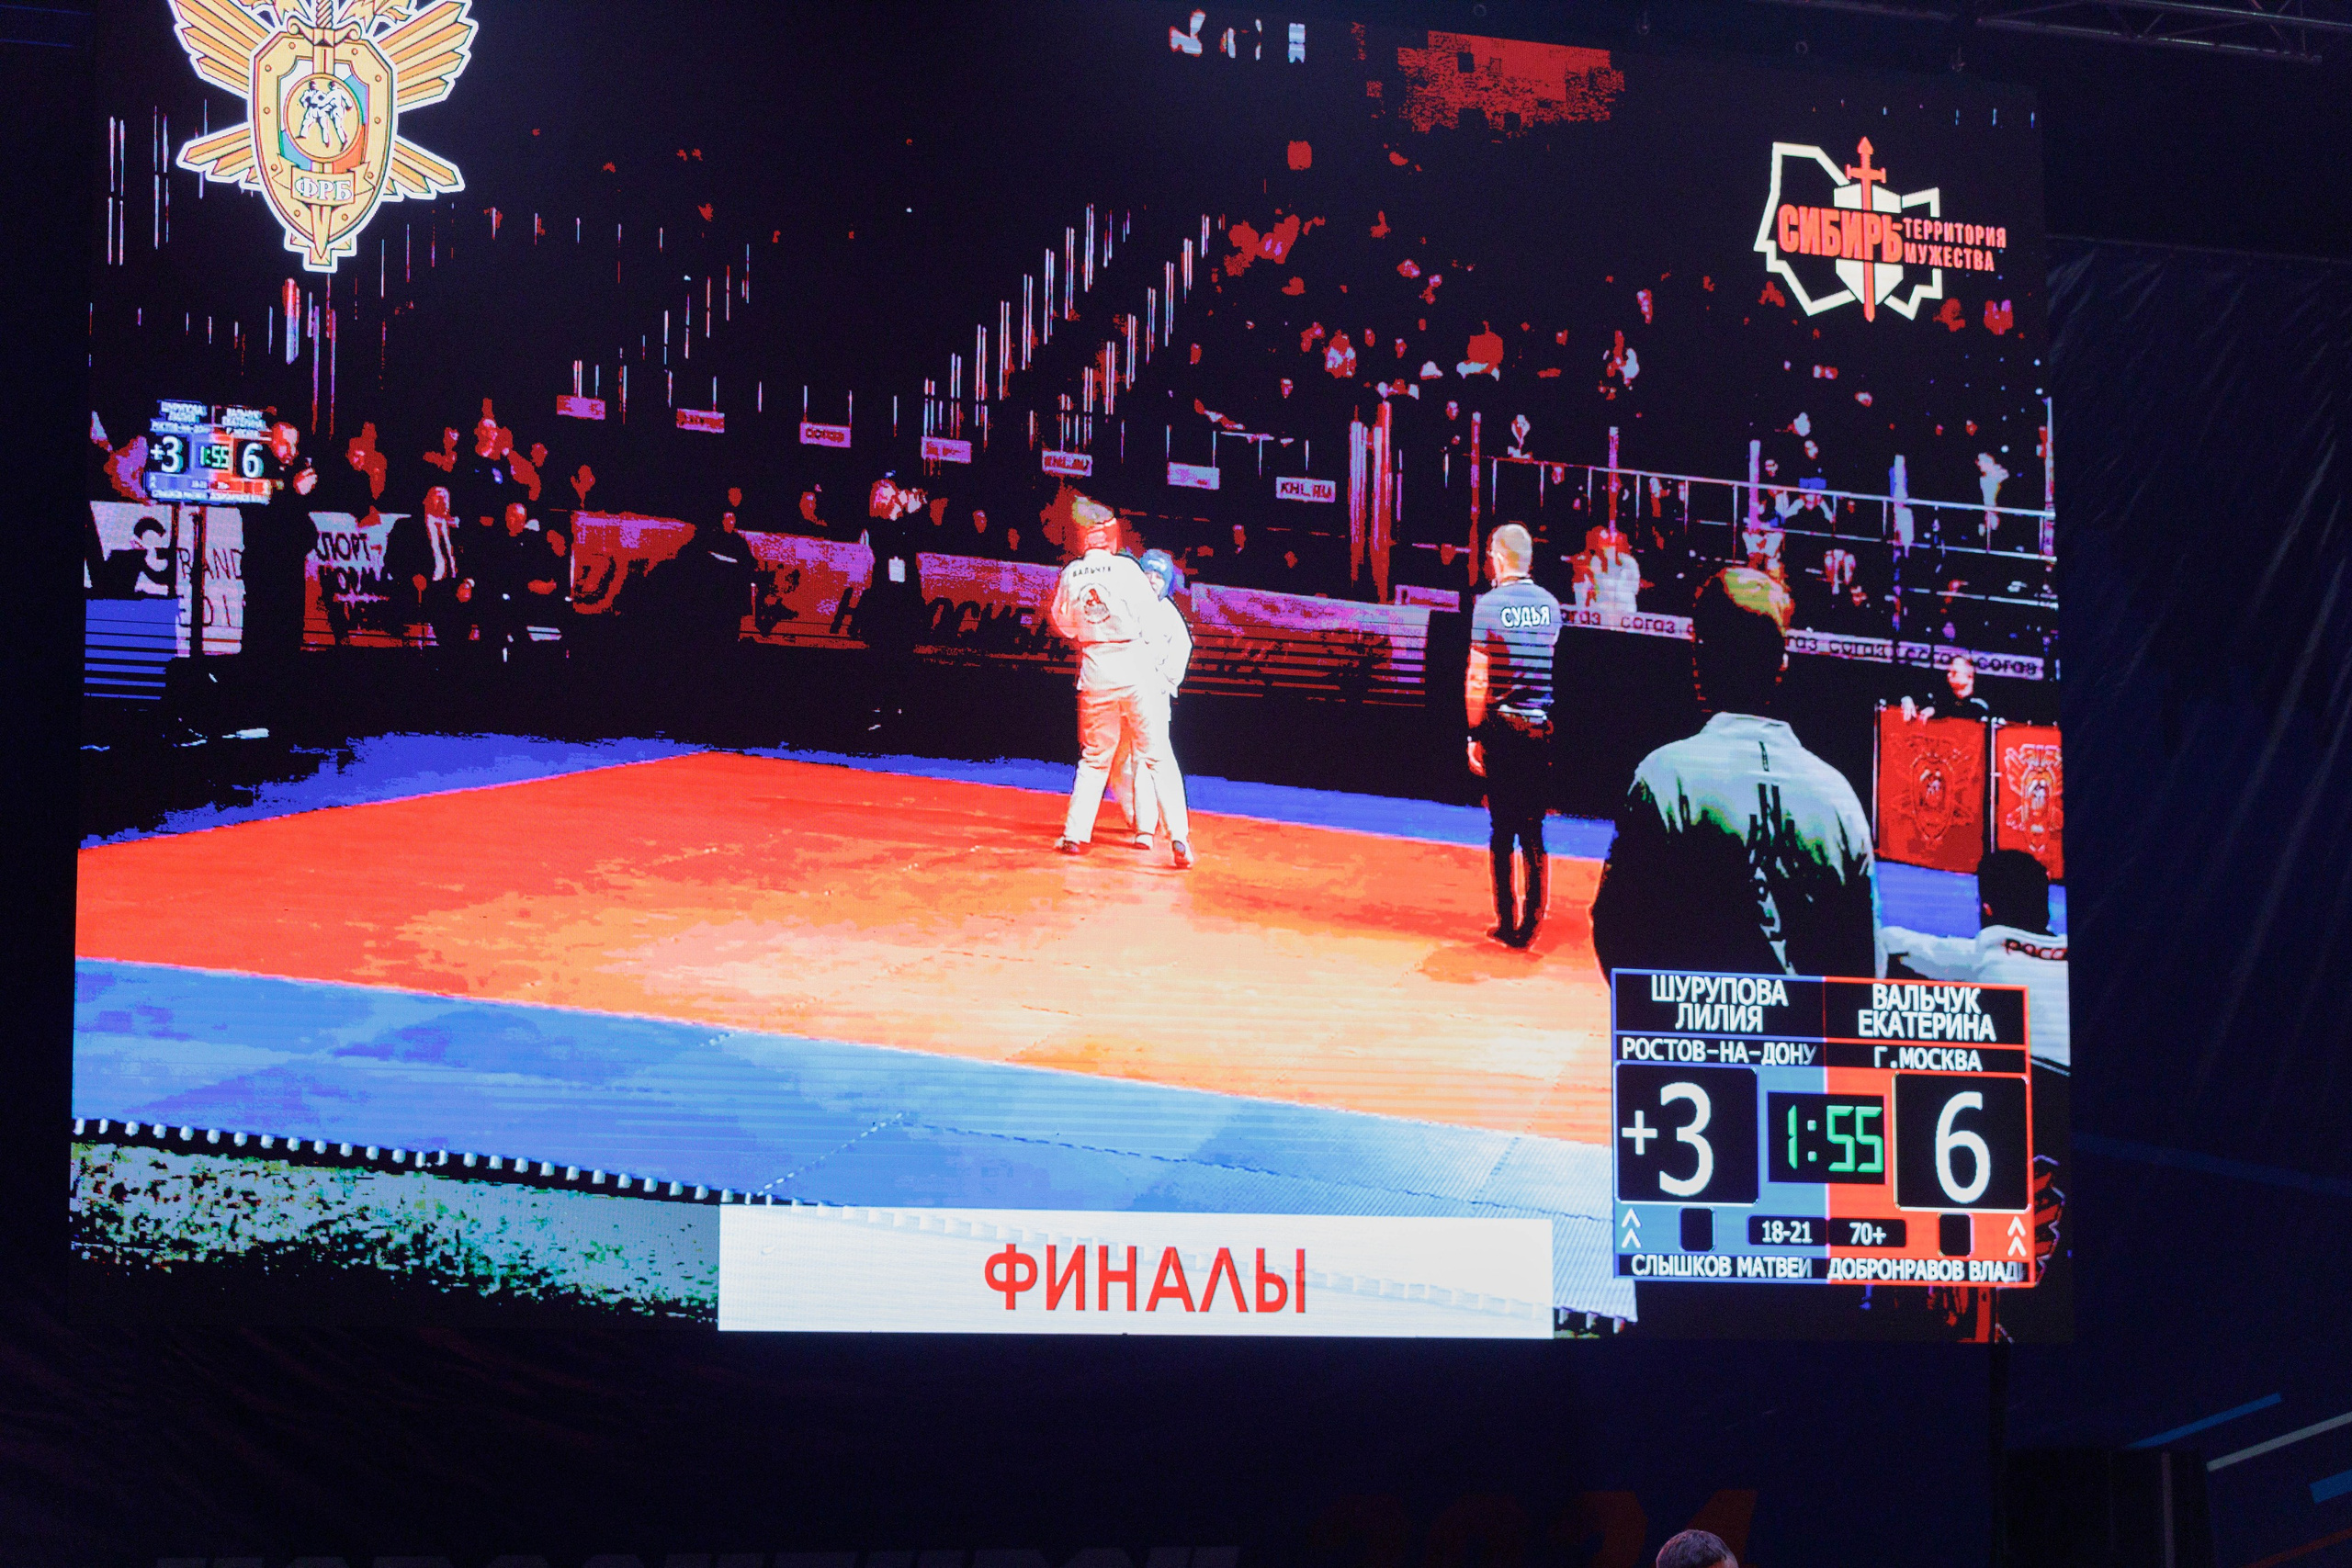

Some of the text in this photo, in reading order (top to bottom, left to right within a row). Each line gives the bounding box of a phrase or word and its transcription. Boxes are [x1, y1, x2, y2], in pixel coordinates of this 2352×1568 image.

[295, 178, 353, 201] ФРБ
[1903, 217, 2007, 249] ТЕРРИТОРИЯ
[1904, 242, 1995, 272] МУЖЕСТВА
[242, 442, 265, 479] 6
[1500, 604, 1551, 628] СУДЬЯ
[1651, 974, 1789, 1007] ШУРУПОВА
[1872, 983, 1982, 1015] ВАЛЬЧУК
[1675, 1002, 1763, 1032] ЛИЛИЯ
[1858, 1009, 1997, 1042] ЕКАТЕРИНА
[1622, 1036, 1817, 1066] РОСТОВ-НА-ДОНУ
[1621, 1081, 1714, 1198] +3
[1787, 1103, 1884, 1174] 1:55
[1935, 1090, 1991, 1204] 6
[1761, 1220, 1814, 1244] 18-21
[1849, 1222, 1887, 1246] 70+
[984, 1243, 1306, 1314] ФИНАЛЫ
[1631, 1253, 1733, 1278] СЛЫШКОВ
[1826, 1257, 1965, 1282] ДОБРОНРАВОВ
